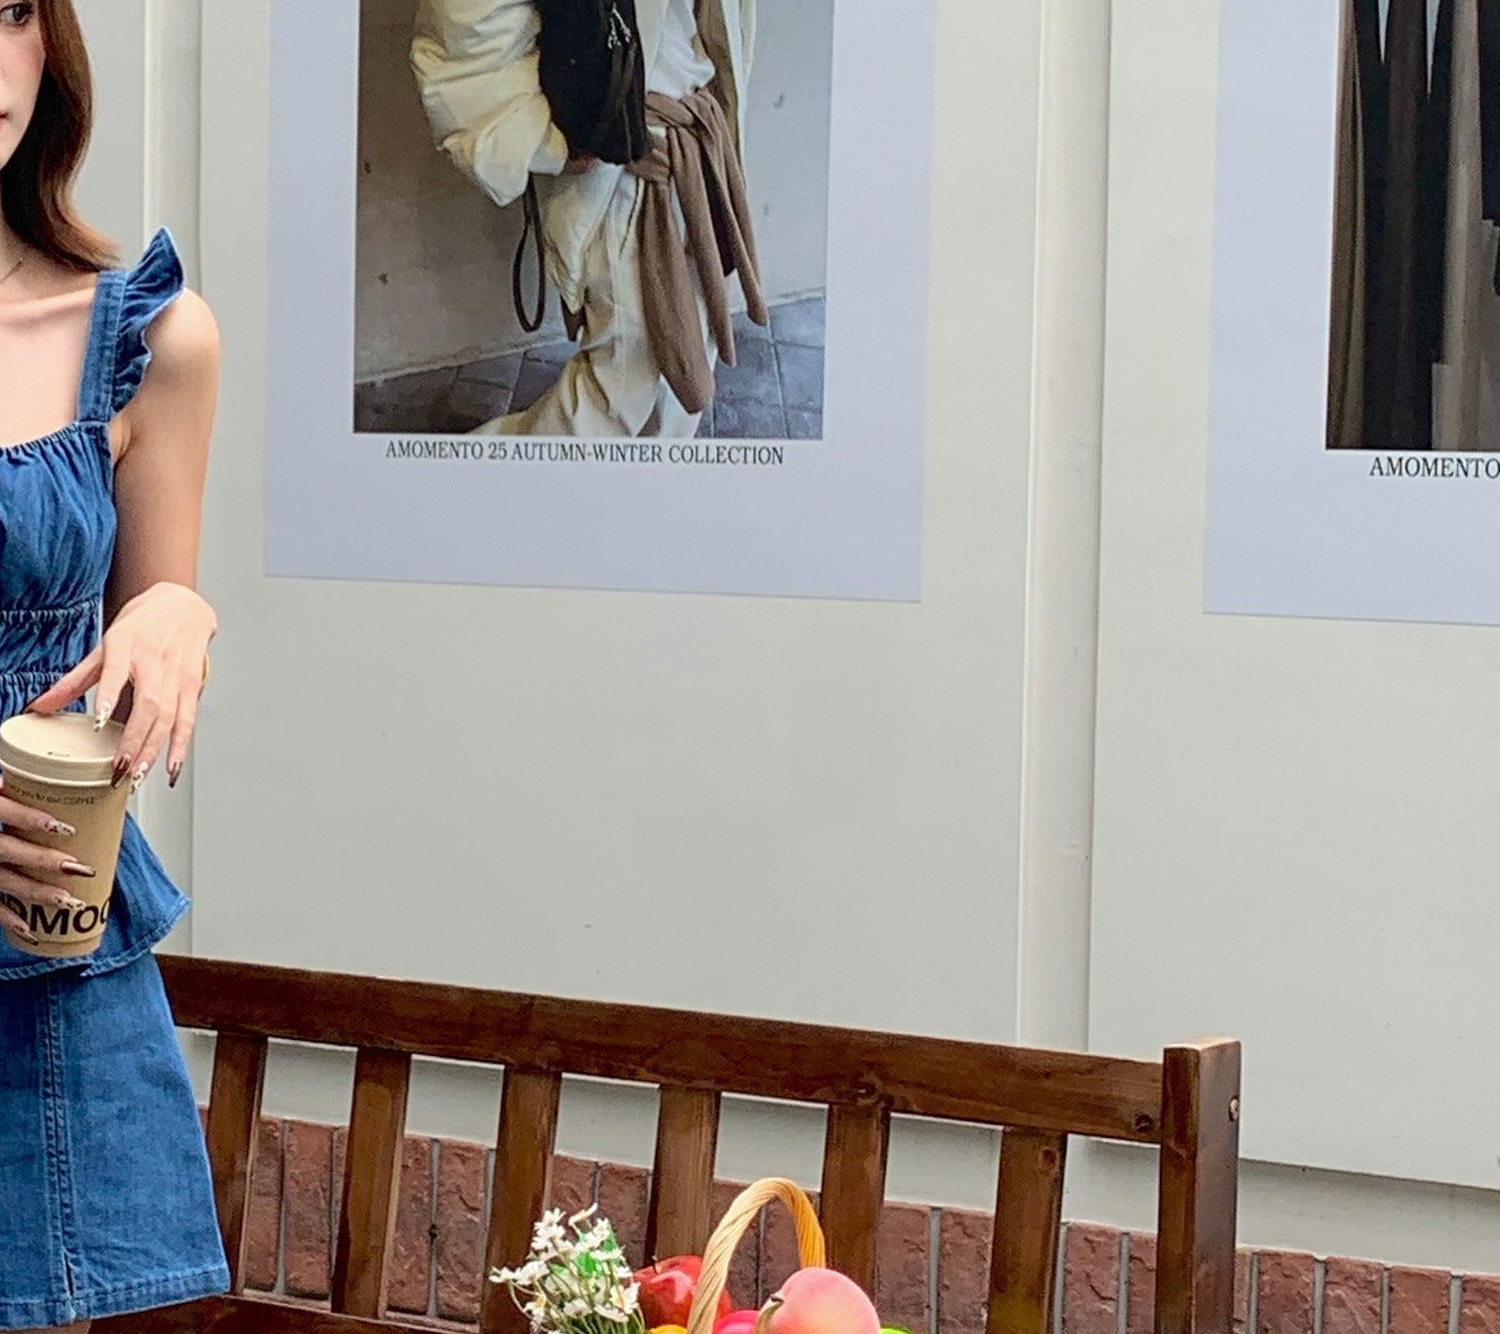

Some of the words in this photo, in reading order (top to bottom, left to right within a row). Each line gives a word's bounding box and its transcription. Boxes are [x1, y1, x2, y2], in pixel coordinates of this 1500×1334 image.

[385, 441, 484, 460] AMOMENTO
[488, 442, 508, 461] 25
[511, 443, 663, 463] AUTUMN-WINTER
[668, 445, 784, 465] COLLECTION
[1369, 456, 1500, 479] AMOMENTO
